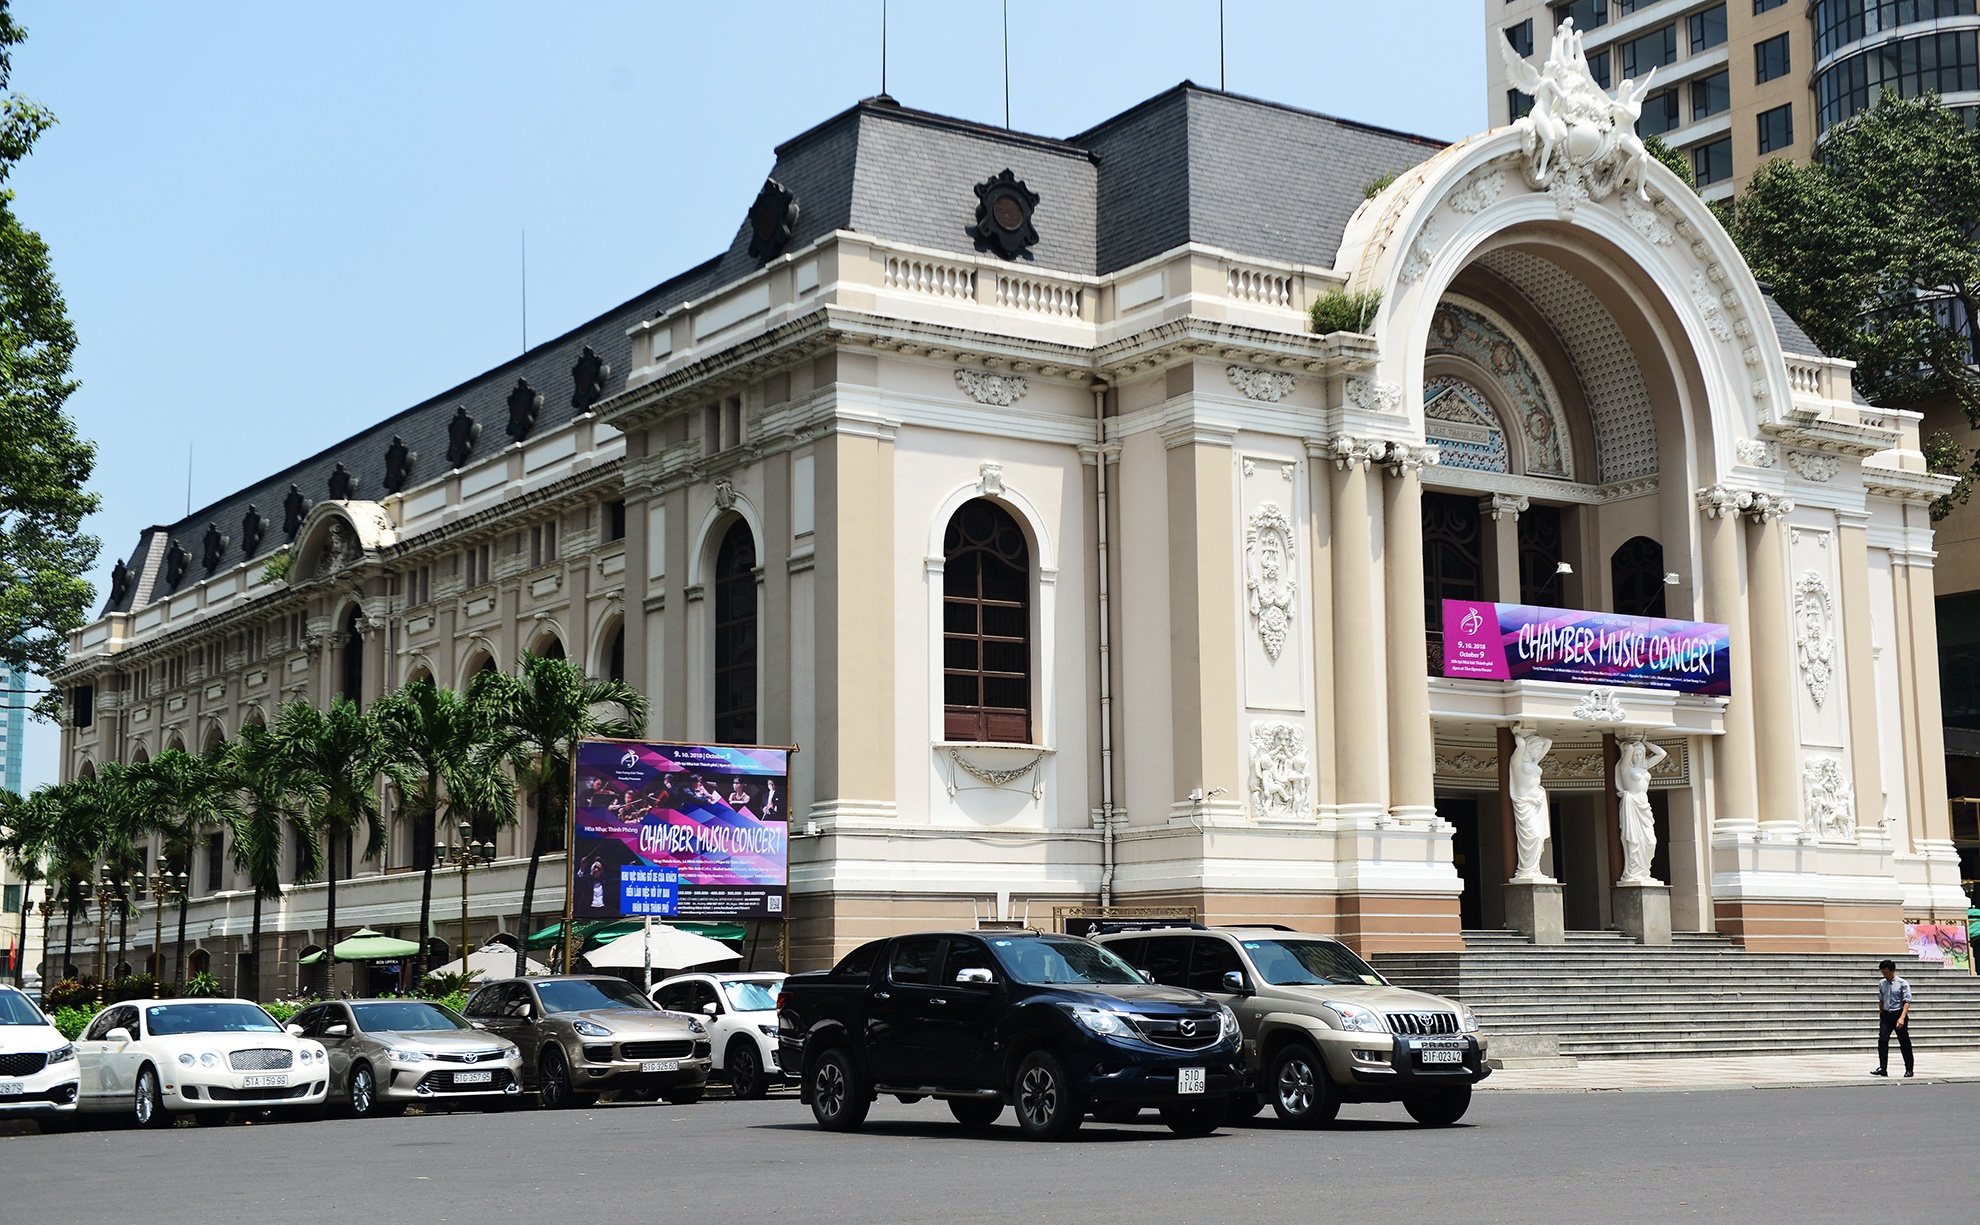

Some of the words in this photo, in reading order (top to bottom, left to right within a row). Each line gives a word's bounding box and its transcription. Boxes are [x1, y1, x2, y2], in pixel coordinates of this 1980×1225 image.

[1518, 622, 1596, 666] CHAMBER
[1599, 628, 1645, 669] MUSIC
[1649, 634, 1717, 676] CONCERT
[1479, 651, 1485, 659] 9
[640, 824, 694, 853] CHAMBER
[696, 825, 729, 853] MUSIC
[732, 826, 782, 854] CONCERT
[1185, 1070, 1199, 1081] 51D
[1180, 1081, 1203, 1092] 114.69
